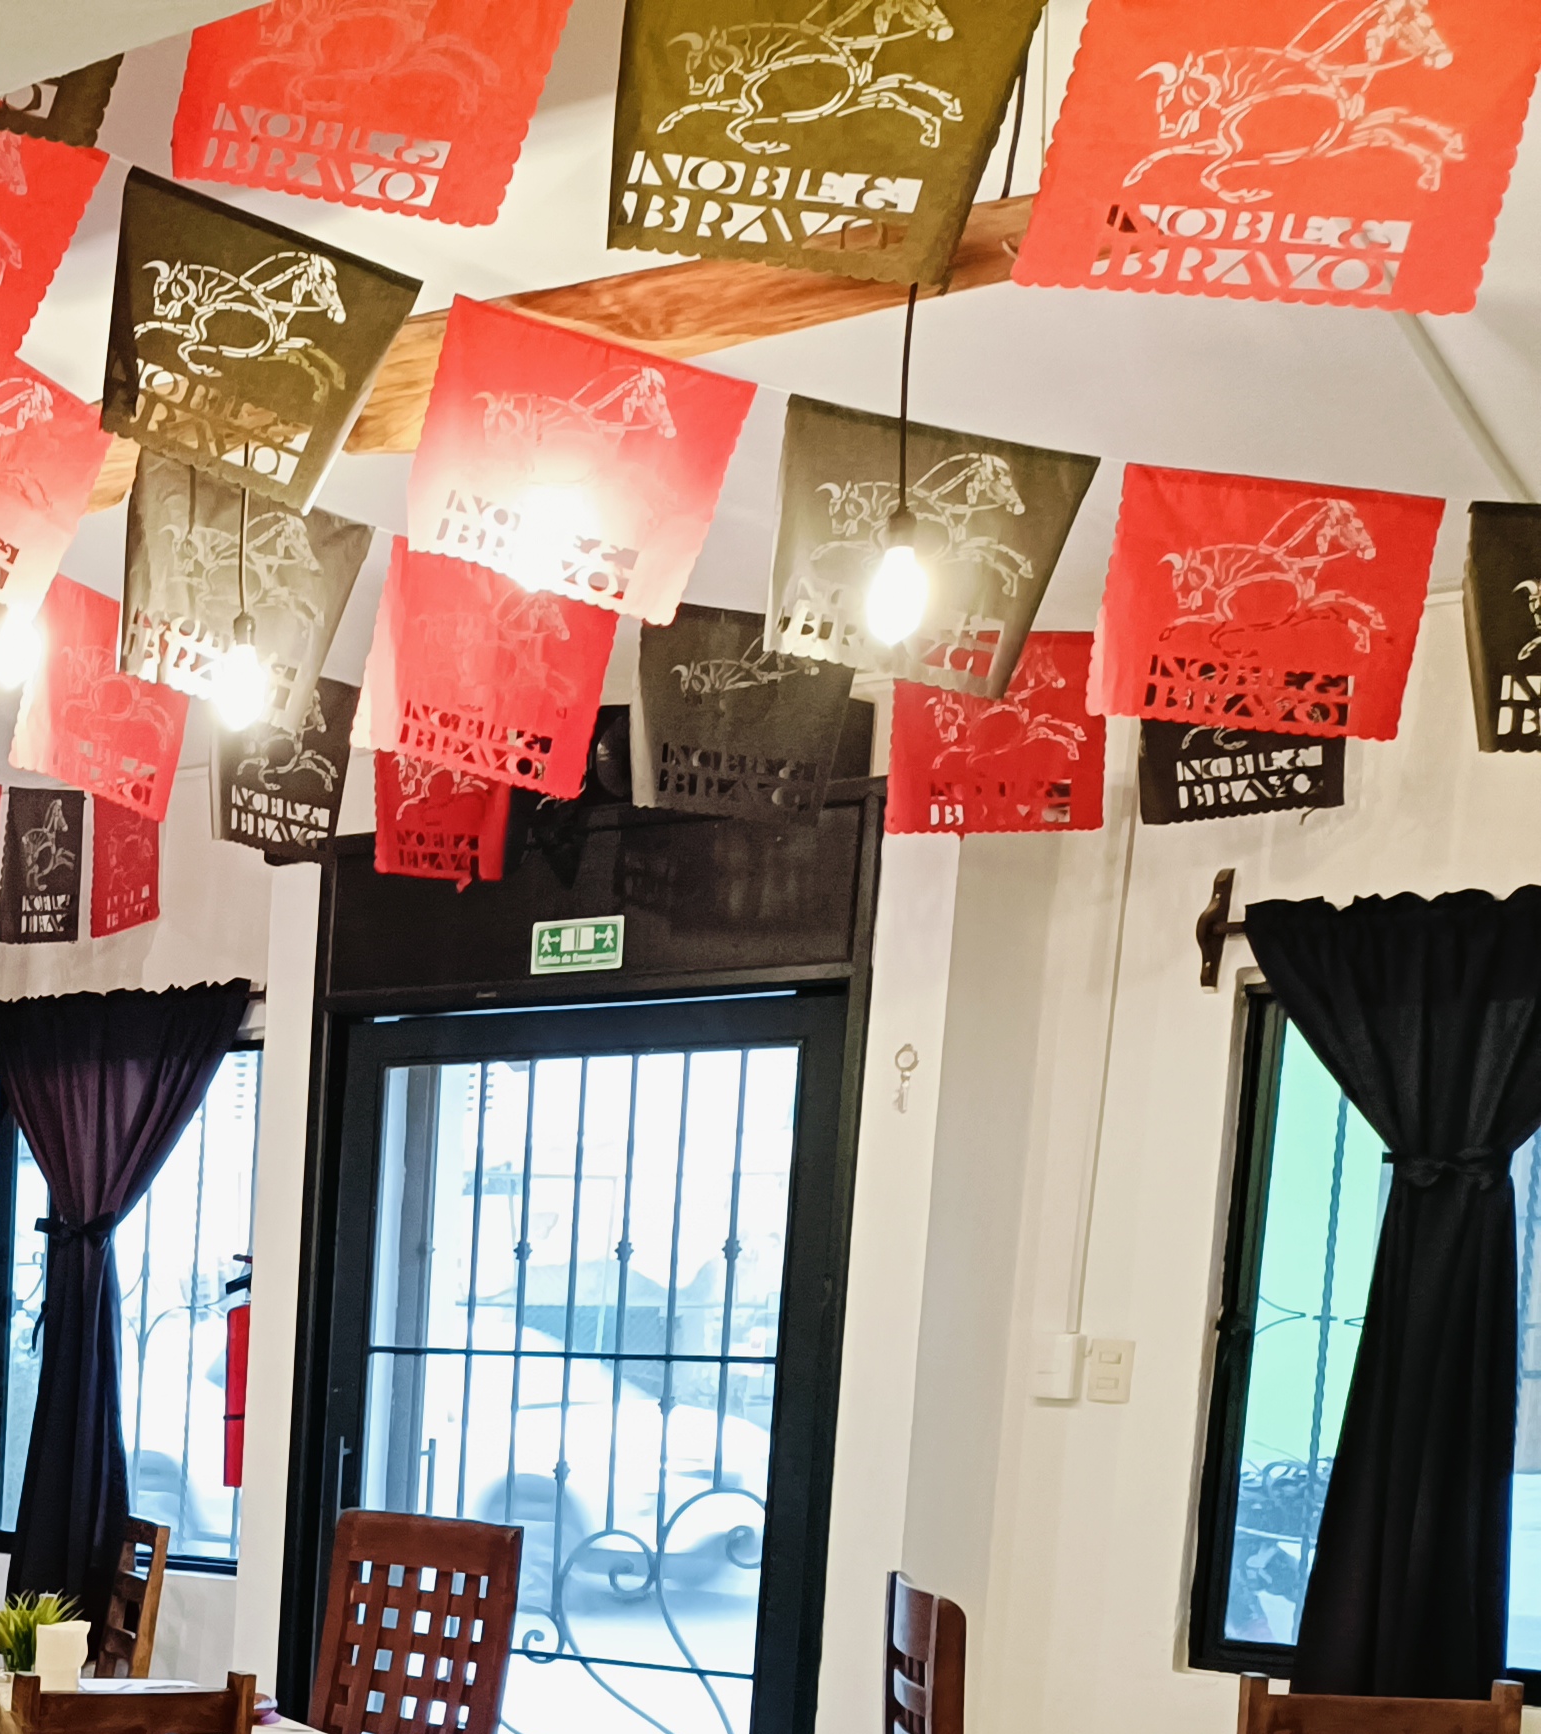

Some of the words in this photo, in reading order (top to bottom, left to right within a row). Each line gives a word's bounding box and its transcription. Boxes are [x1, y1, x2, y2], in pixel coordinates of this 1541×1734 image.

[202, 137, 440, 208] BRAVO
[622, 191, 910, 250] BRAVO
[1090, 246, 1402, 295] BRAVO
[1143, 682, 1351, 728] BRAVO
[398, 725, 547, 781] BRAVO
